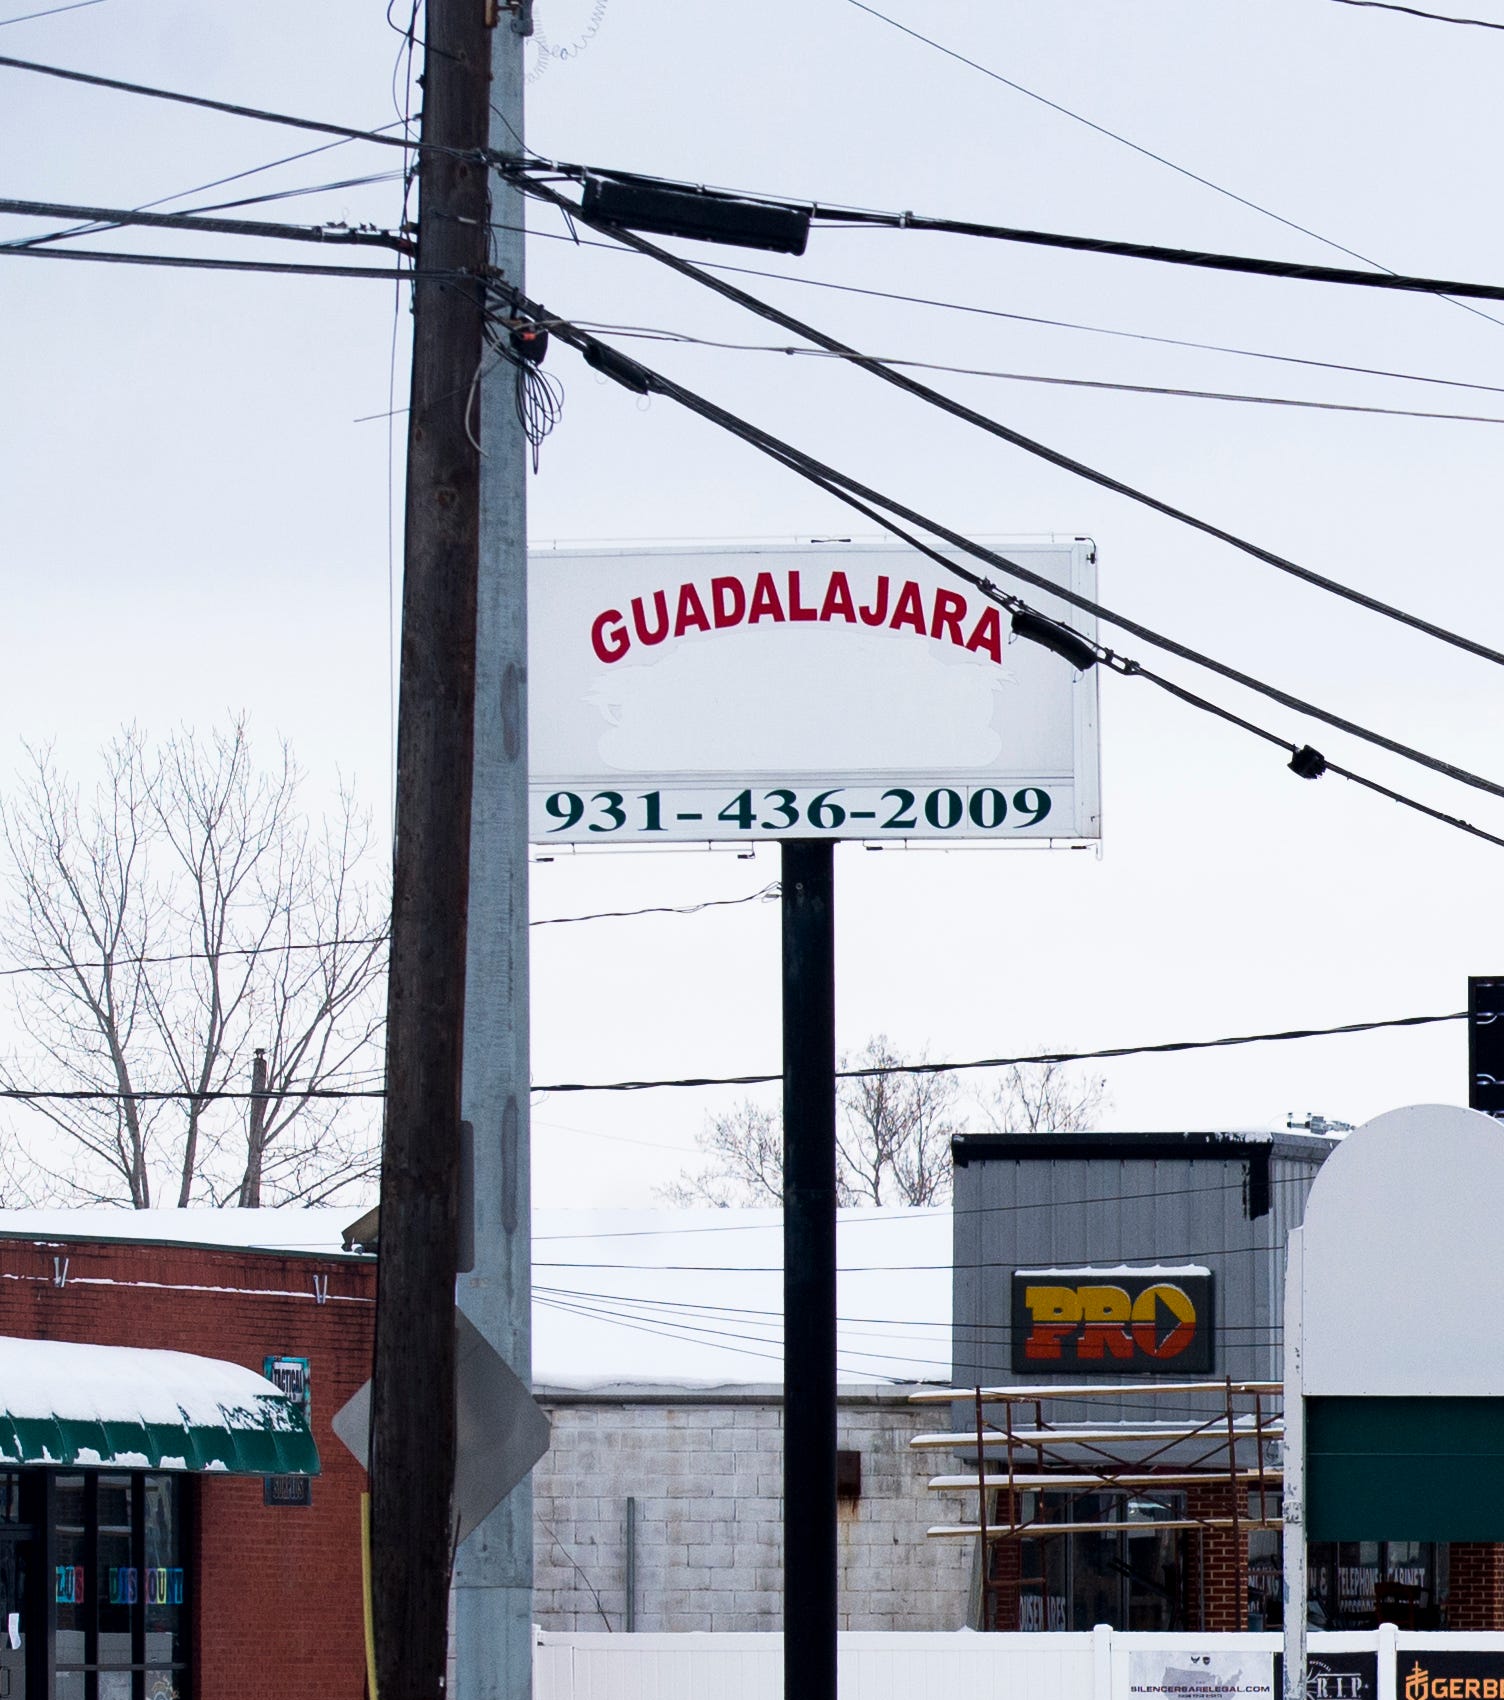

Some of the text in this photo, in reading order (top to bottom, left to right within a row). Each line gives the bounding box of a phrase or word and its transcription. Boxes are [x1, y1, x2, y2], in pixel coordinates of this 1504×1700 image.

[590, 569, 1002, 665] GUADALAJARA
[545, 787, 1052, 833] 931-436-2009
[1024, 1283, 1197, 1360] PRO
